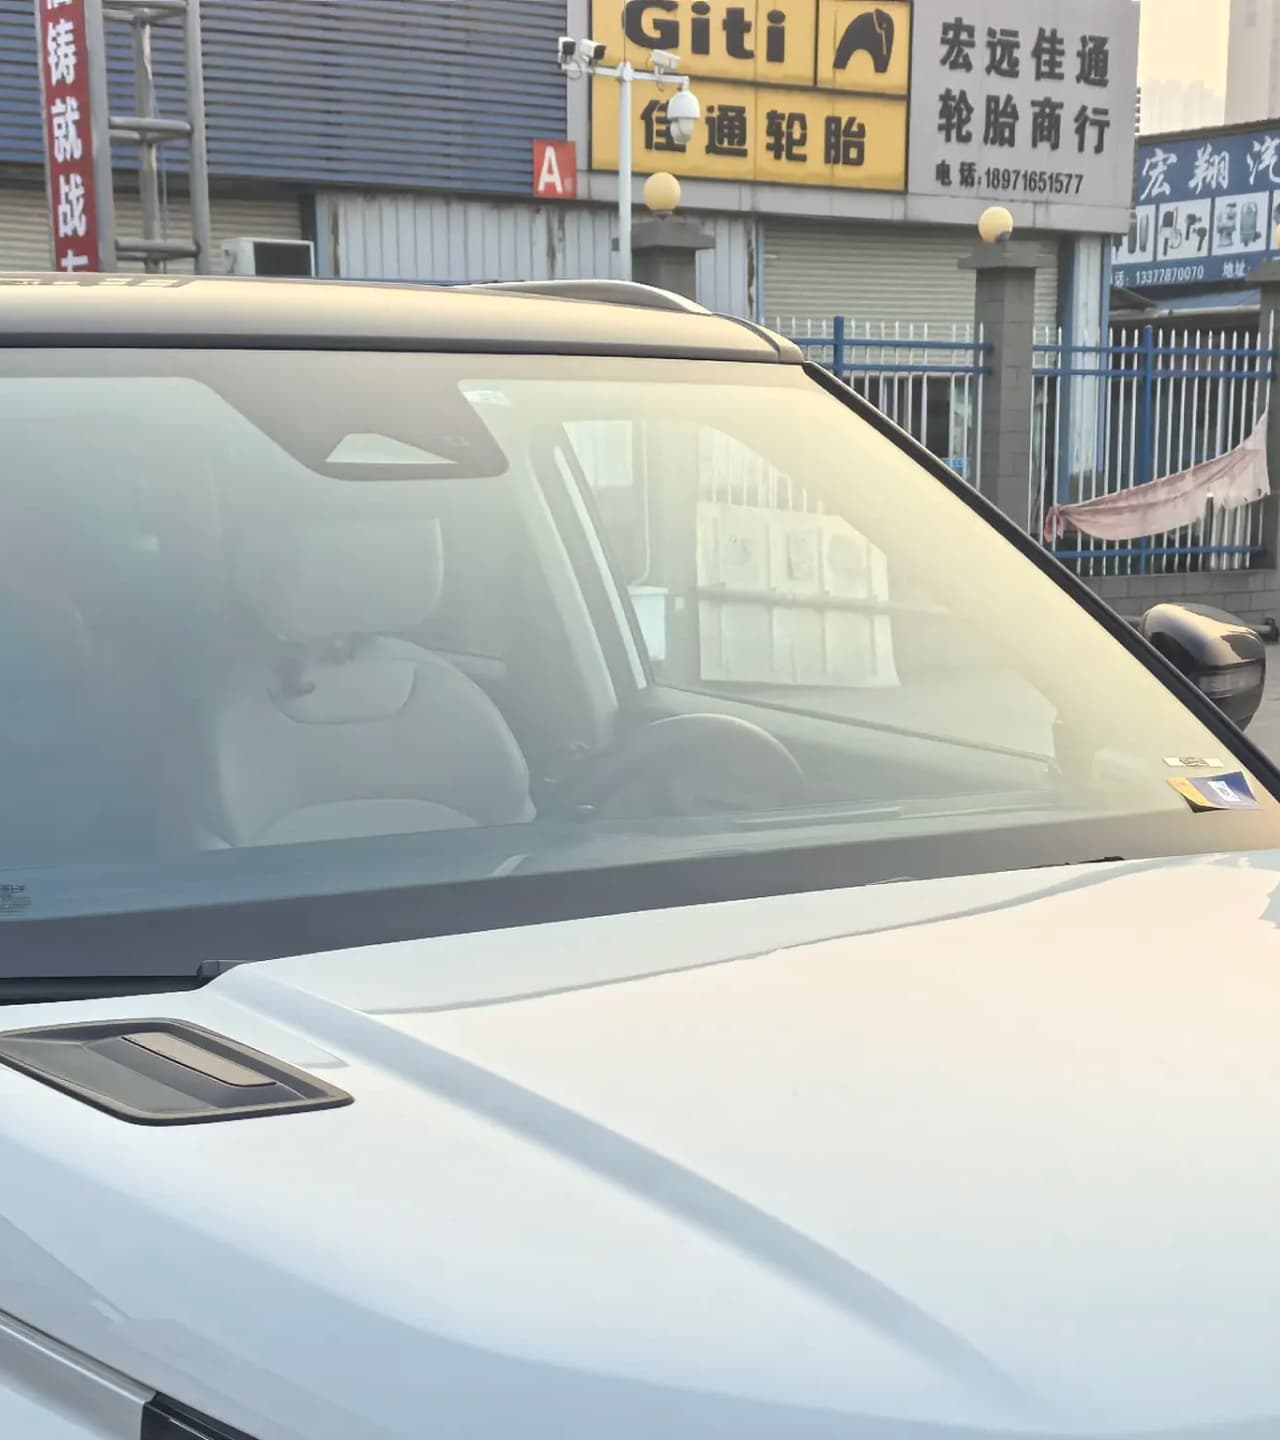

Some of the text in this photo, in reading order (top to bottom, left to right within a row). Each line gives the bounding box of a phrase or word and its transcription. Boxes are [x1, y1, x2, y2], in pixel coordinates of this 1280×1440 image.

[622, 0, 786, 63] Giti
[939, 17, 1110, 87] 宏远佳通
[45, 0, 89, 272] 铸就战
[640, 99, 866, 166] 佳通轮胎
[937, 88, 1110, 154] 轮胎商行
[537, 146, 564, 194] A
[935, 160, 1084, 195] 电话:18971651577
[1110, 265, 1204, 288] 话:13377870070
